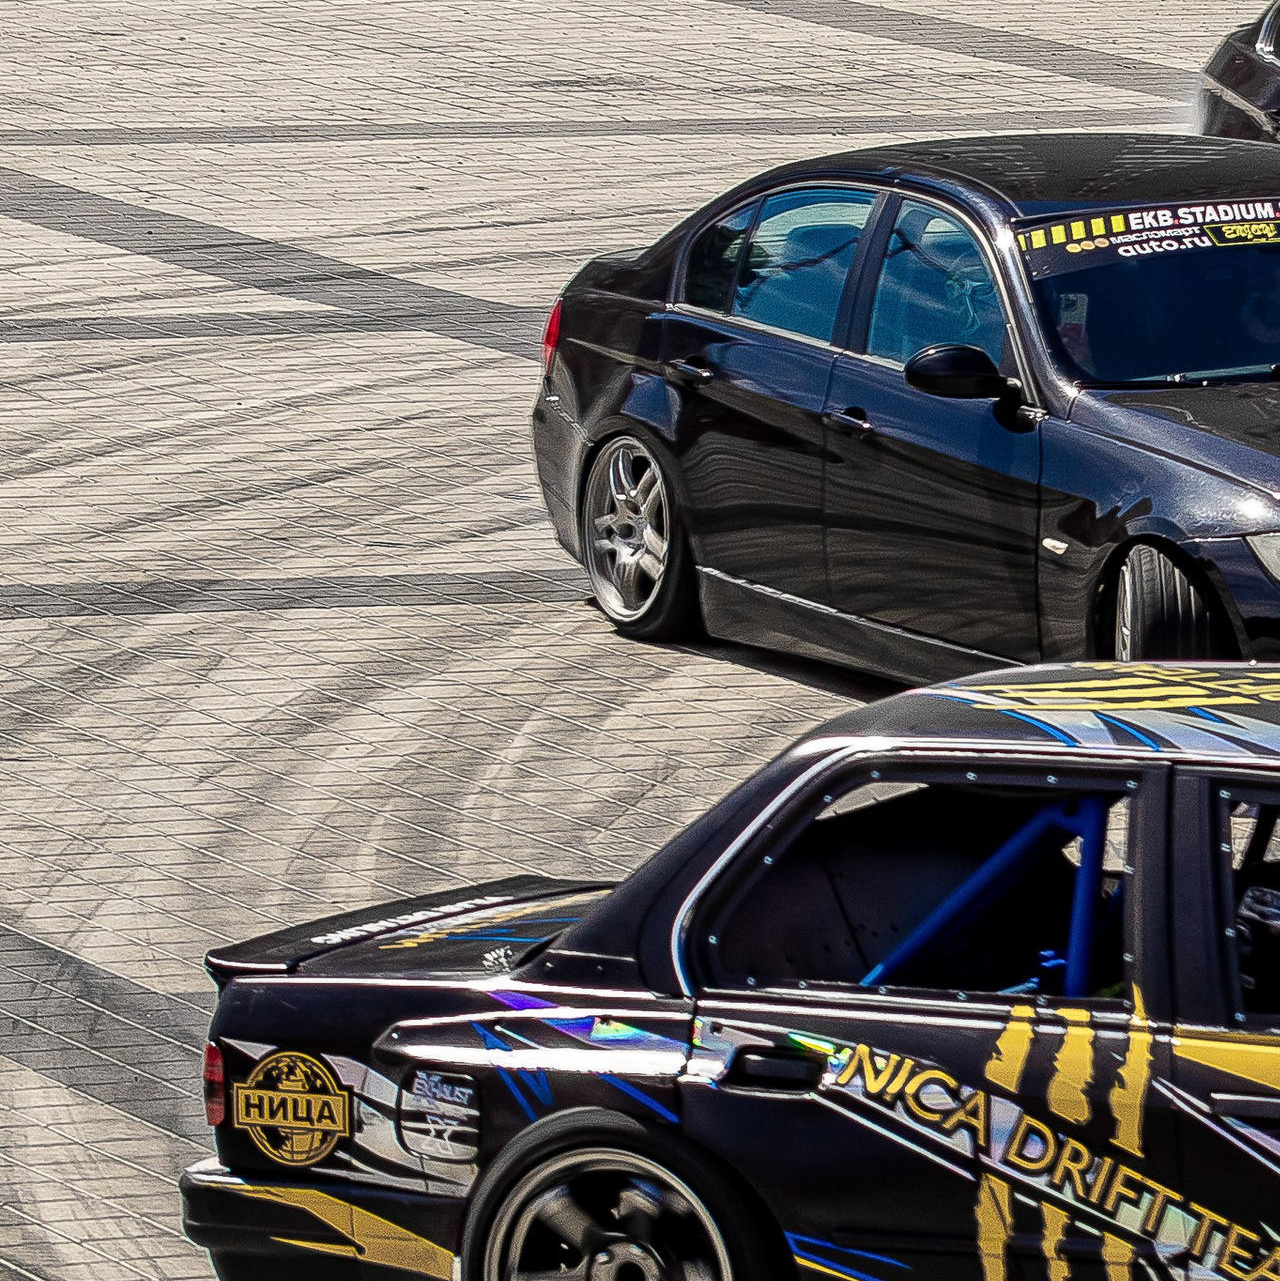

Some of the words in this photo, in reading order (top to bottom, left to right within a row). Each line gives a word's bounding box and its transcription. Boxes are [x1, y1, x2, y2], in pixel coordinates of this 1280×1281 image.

[1118, 236, 1213, 257] auto.ru
[244, 1094, 338, 1127] НИЦА
[838, 1042, 992, 1158] NICA
[1003, 1116, 1184, 1234] DRIFT
